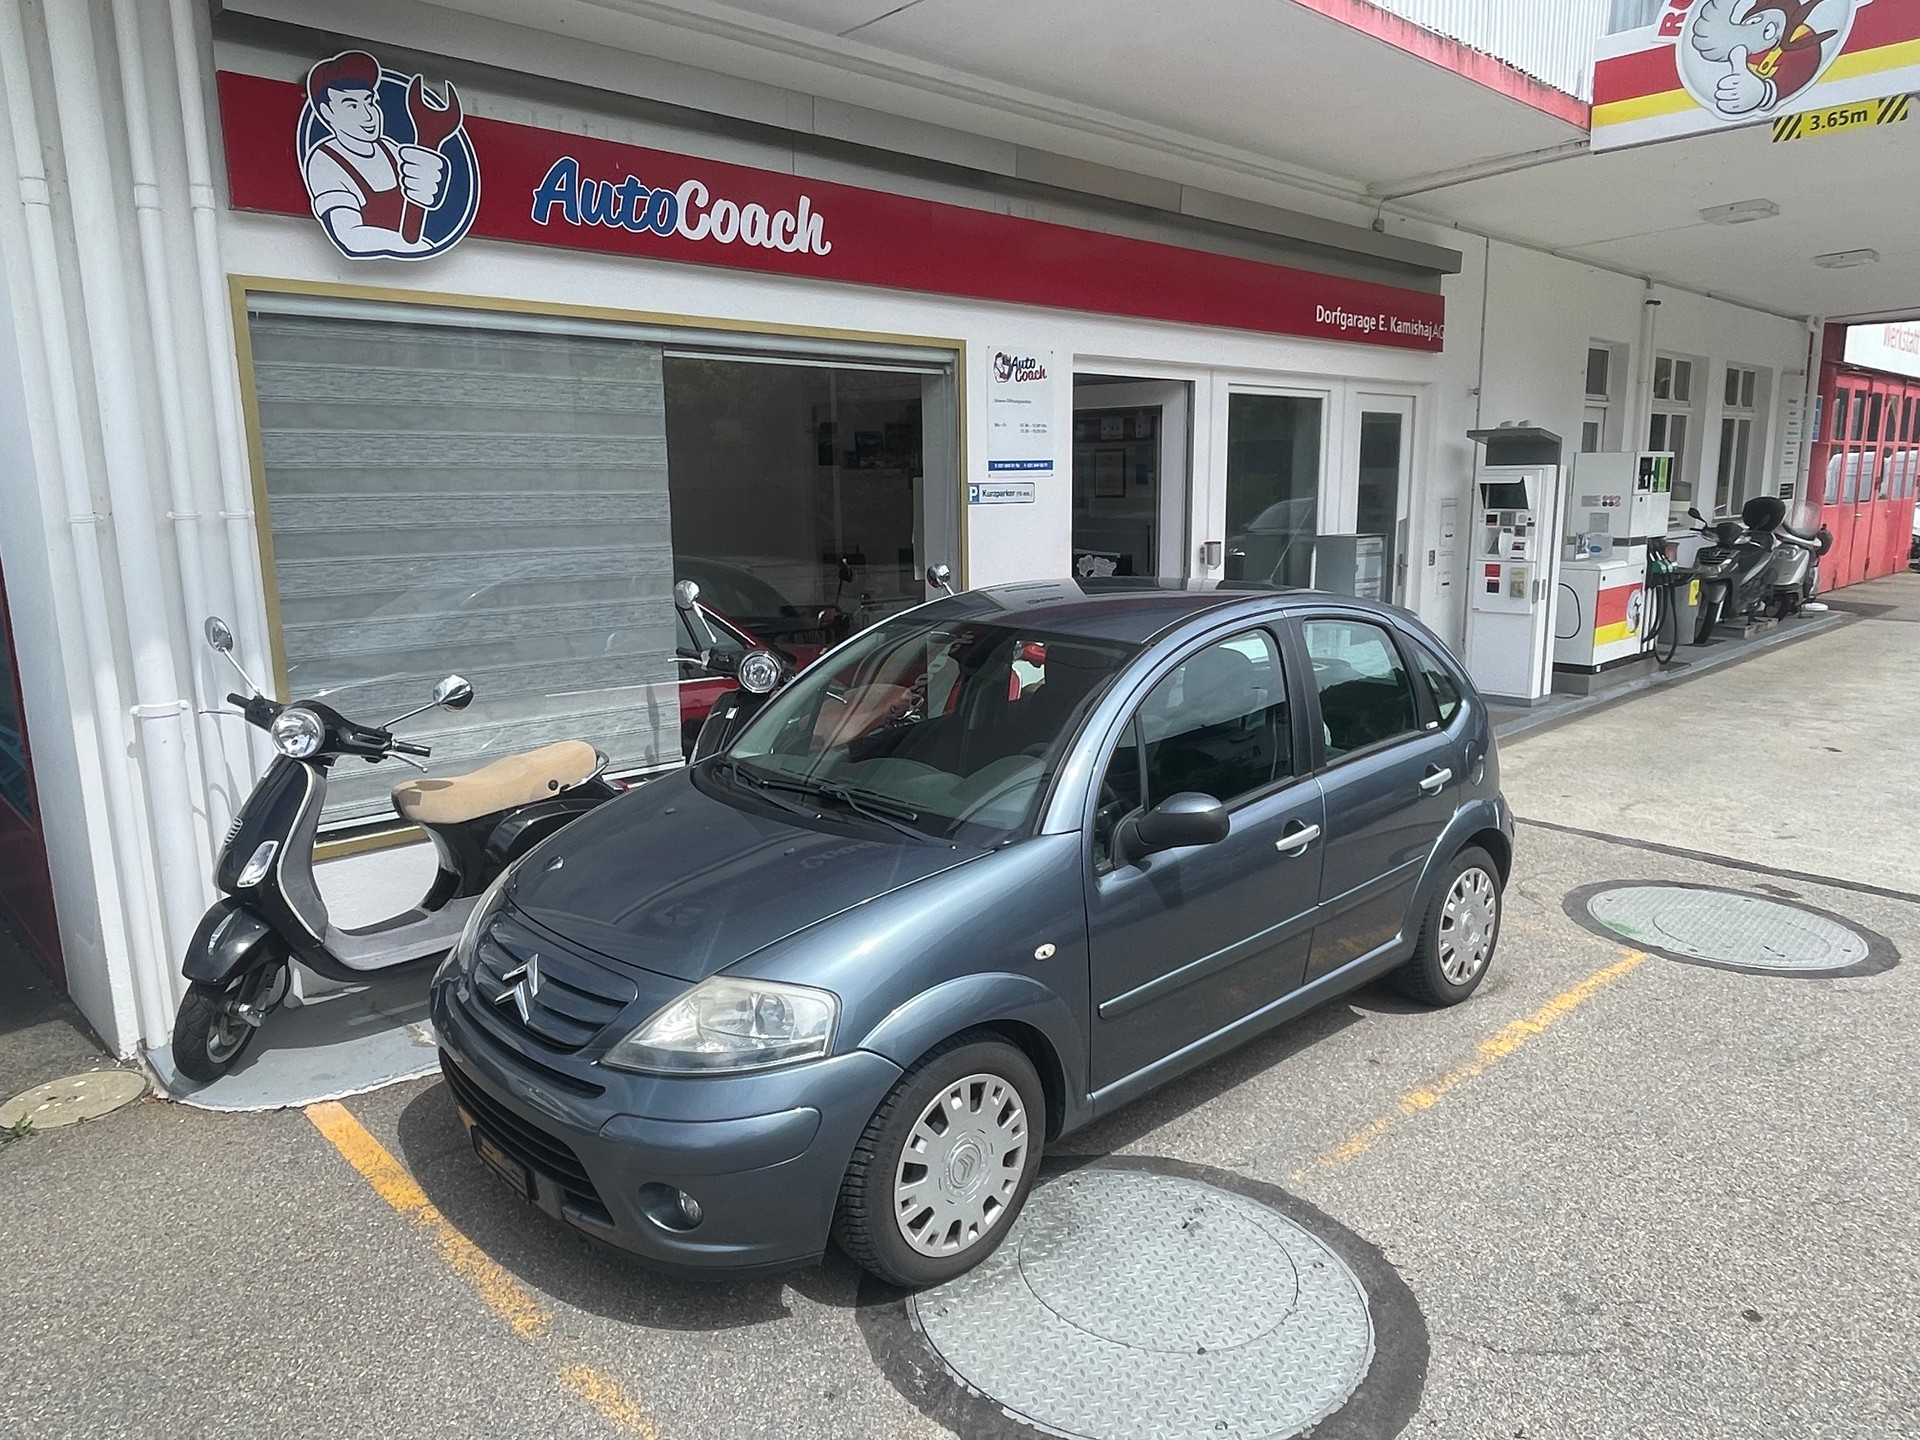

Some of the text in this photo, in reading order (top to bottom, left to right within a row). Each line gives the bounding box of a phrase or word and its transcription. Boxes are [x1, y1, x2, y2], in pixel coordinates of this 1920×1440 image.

[1810, 110, 1868, 131] 3.65m
[1316, 304, 1376, 333] Dorfgarage
[1379, 314, 1387, 331] E.
[1390, 316, 1432, 341] Kamishaj
[1011, 356, 1036, 371] Auto
[1015, 364, 1047, 382] Coach
[969, 486, 978, 502] P
[982, 489, 1016, 499] Kurzparker
